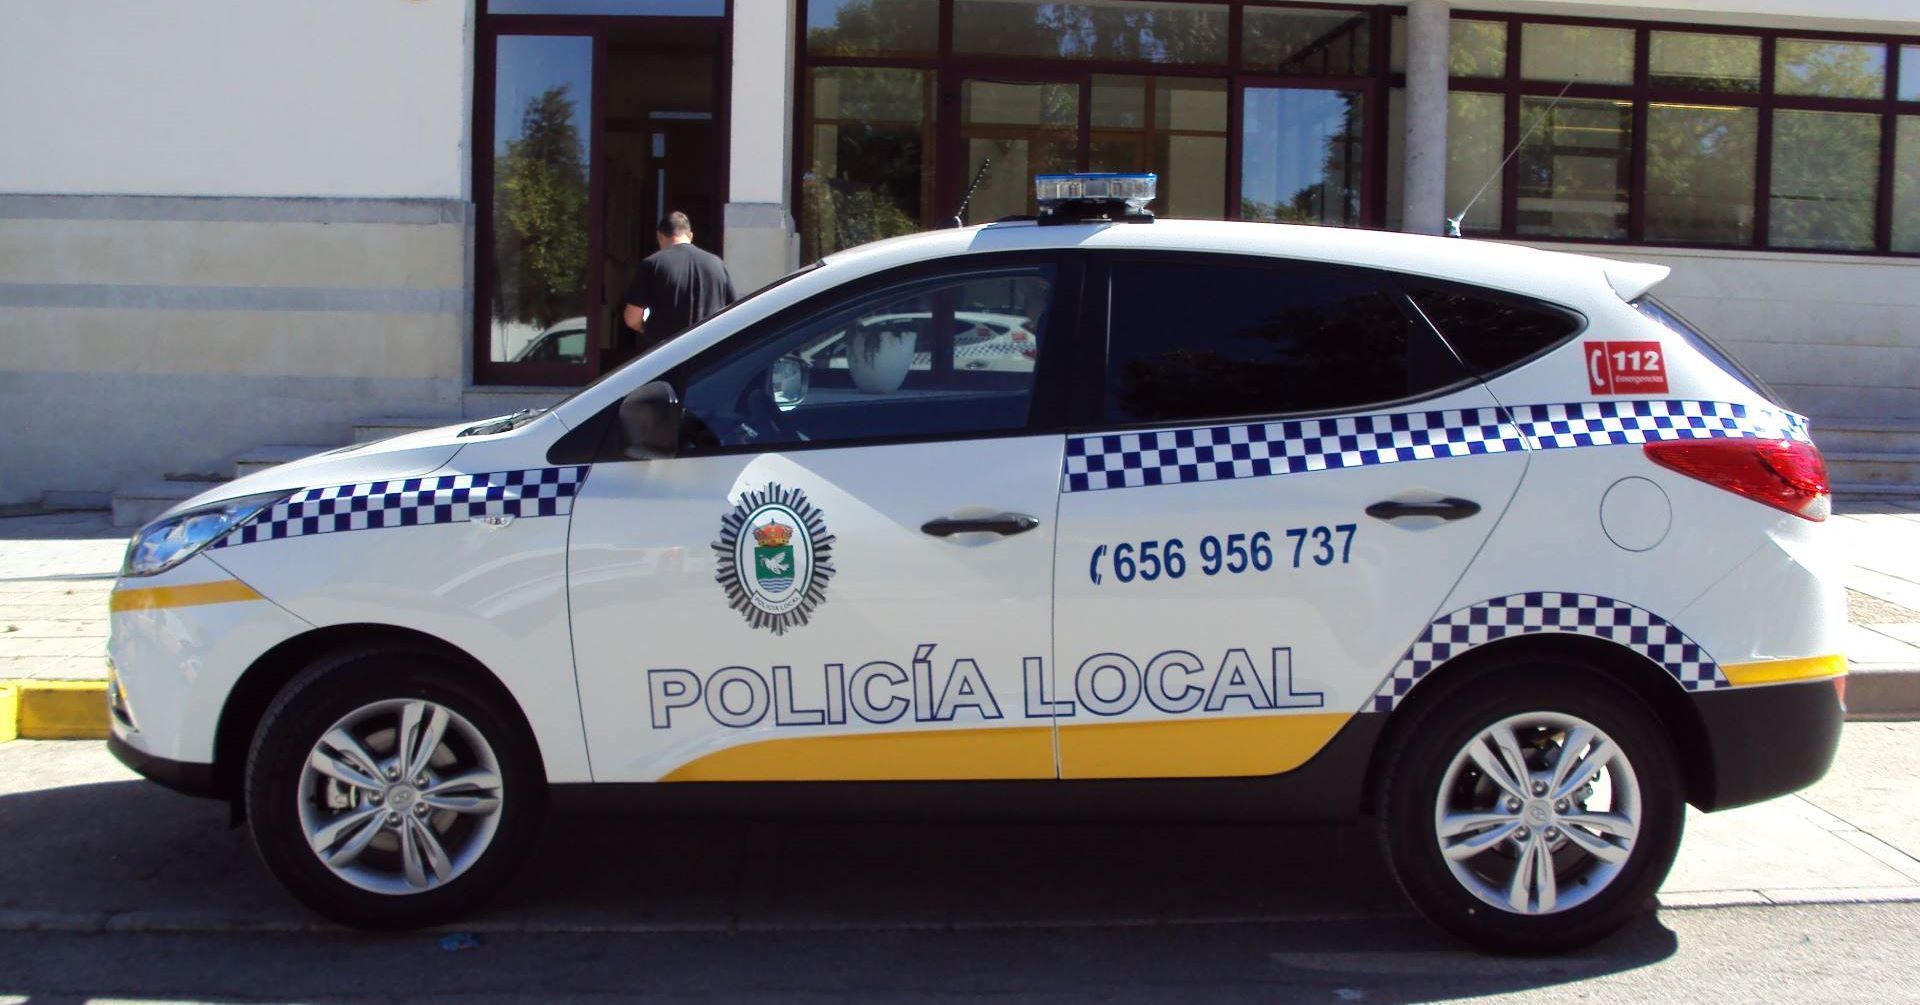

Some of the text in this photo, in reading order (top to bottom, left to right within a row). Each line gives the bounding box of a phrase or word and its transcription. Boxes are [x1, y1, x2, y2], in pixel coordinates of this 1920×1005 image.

[1612, 350, 1660, 371] 112
[1615, 375, 1664, 384] Emergencias
[1113, 523, 1357, 583] 656 956 737
[647, 643, 1324, 729] POLICÍA LOCAL
